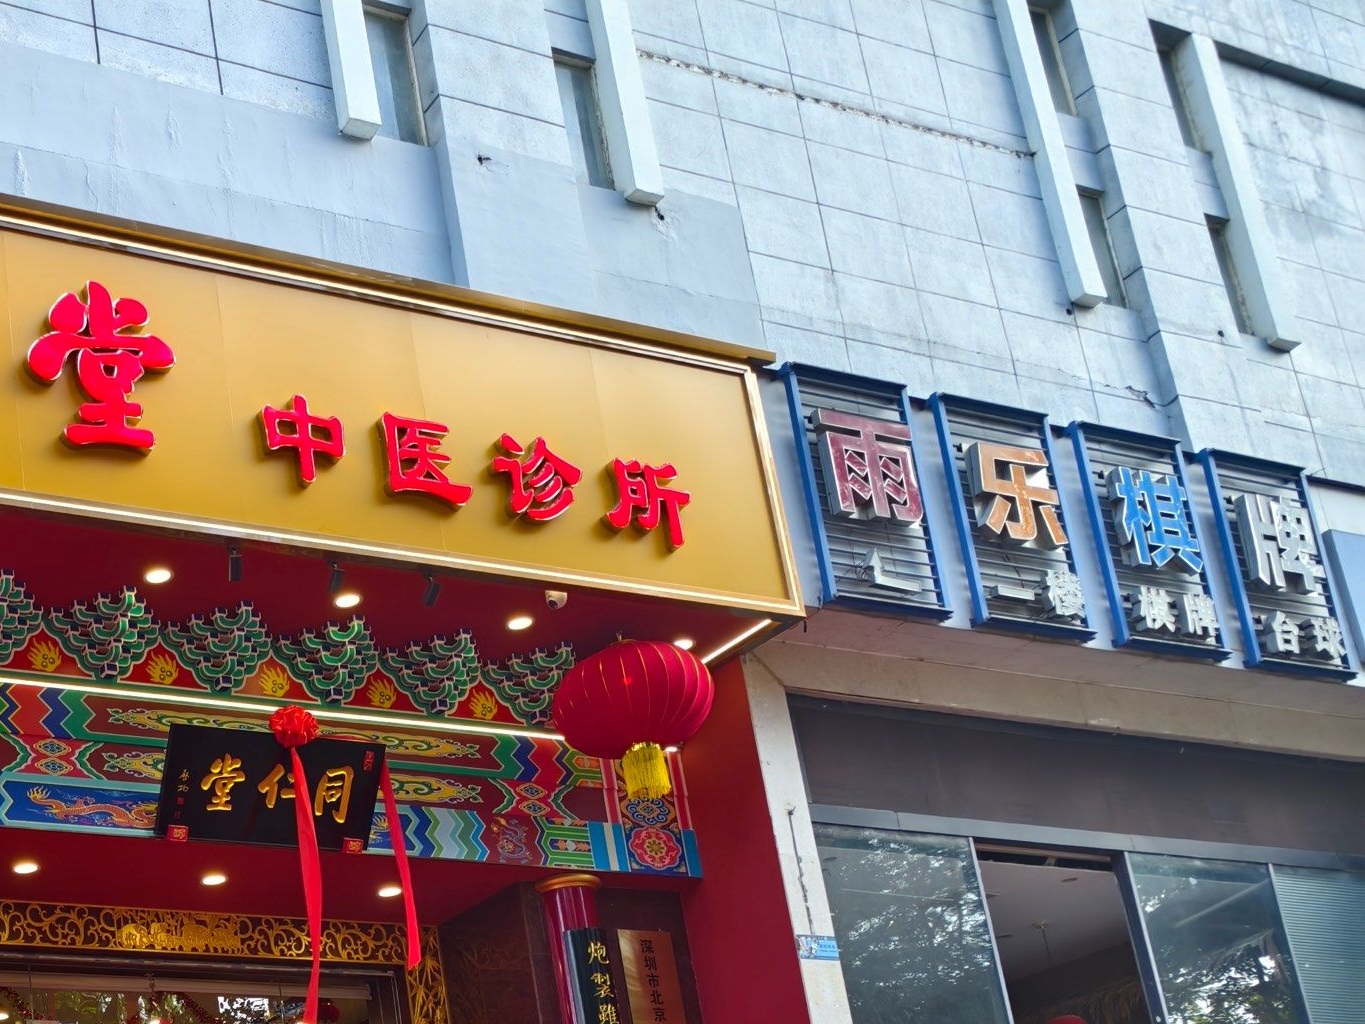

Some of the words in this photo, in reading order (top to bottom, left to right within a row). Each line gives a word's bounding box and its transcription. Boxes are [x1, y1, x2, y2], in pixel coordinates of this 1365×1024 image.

[259, 394, 691, 552] 中医诊所
[1137, 584, 1220, 637] 棋牌
[1265, 609, 1346, 660] 台球
